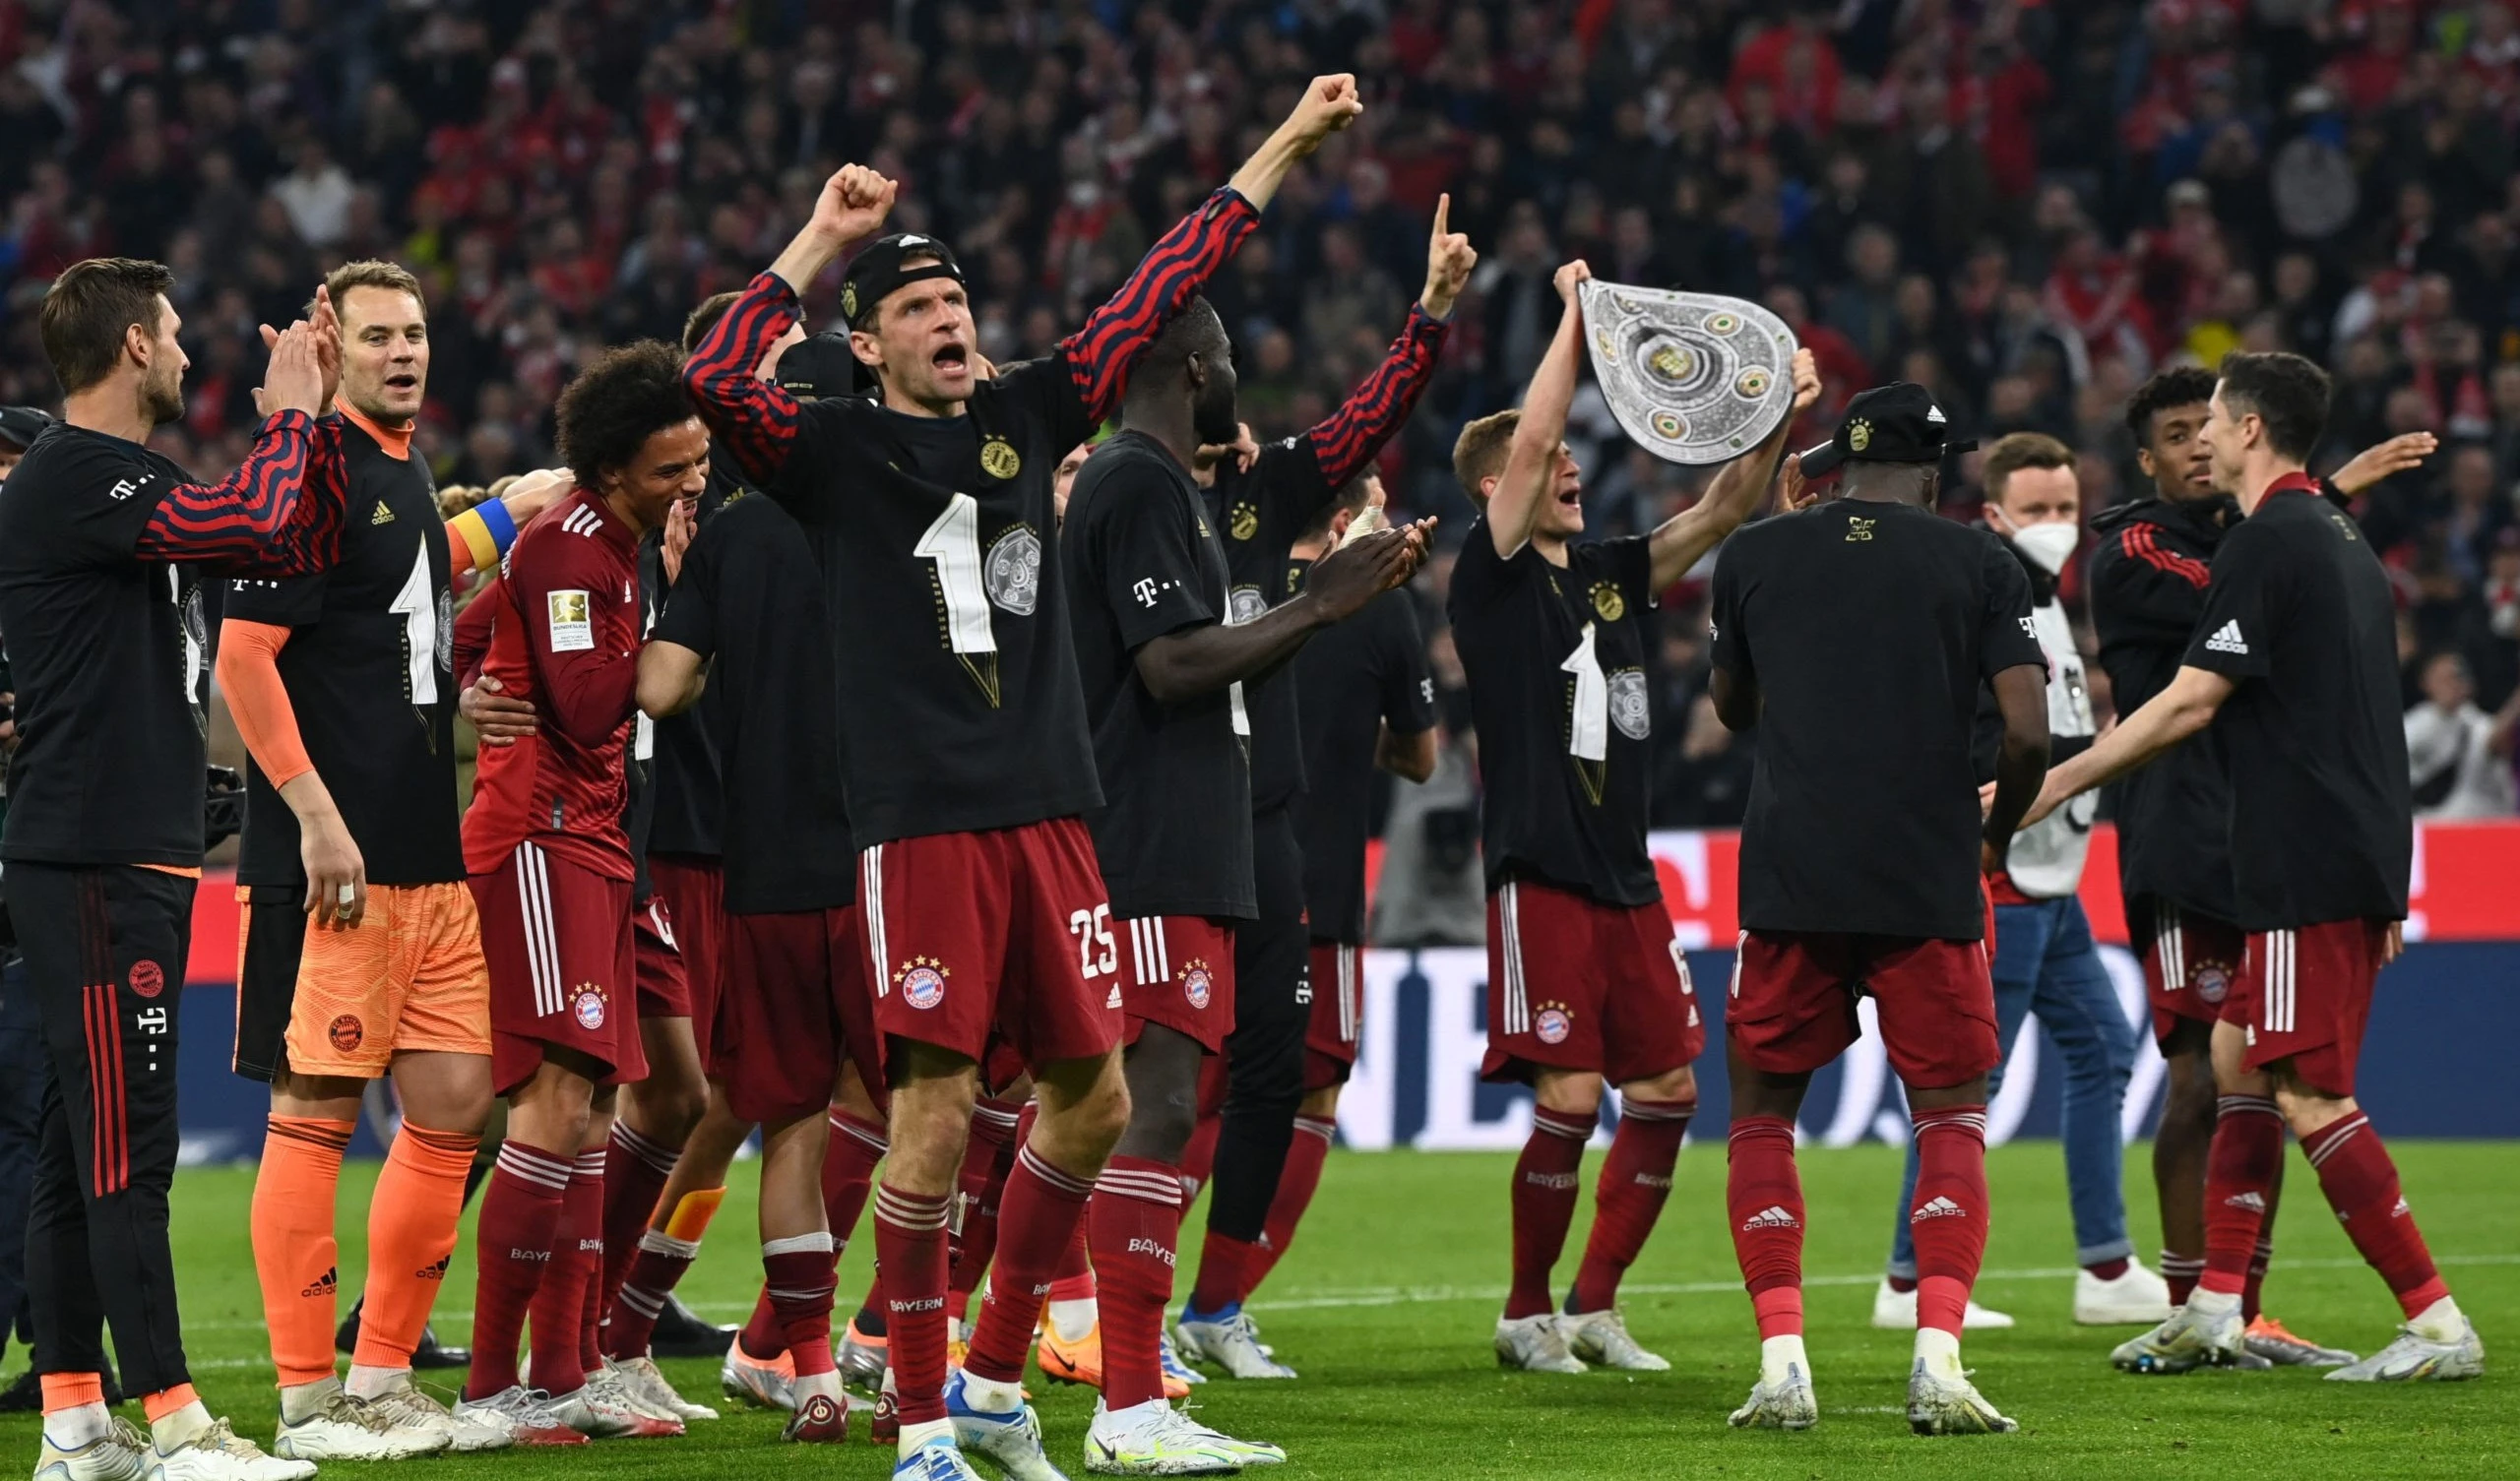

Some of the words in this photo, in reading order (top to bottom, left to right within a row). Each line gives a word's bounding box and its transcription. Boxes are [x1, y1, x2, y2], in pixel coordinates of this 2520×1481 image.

[2205, 640, 2248, 654] adidas
[1070, 902, 1117, 979] 25
[1668, 938, 1693, 995] 6
[1911, 1208, 1966, 1223] adidas
[1743, 1219, 1799, 1231] adidas
[890, 1297, 943, 1312] BAYERN
